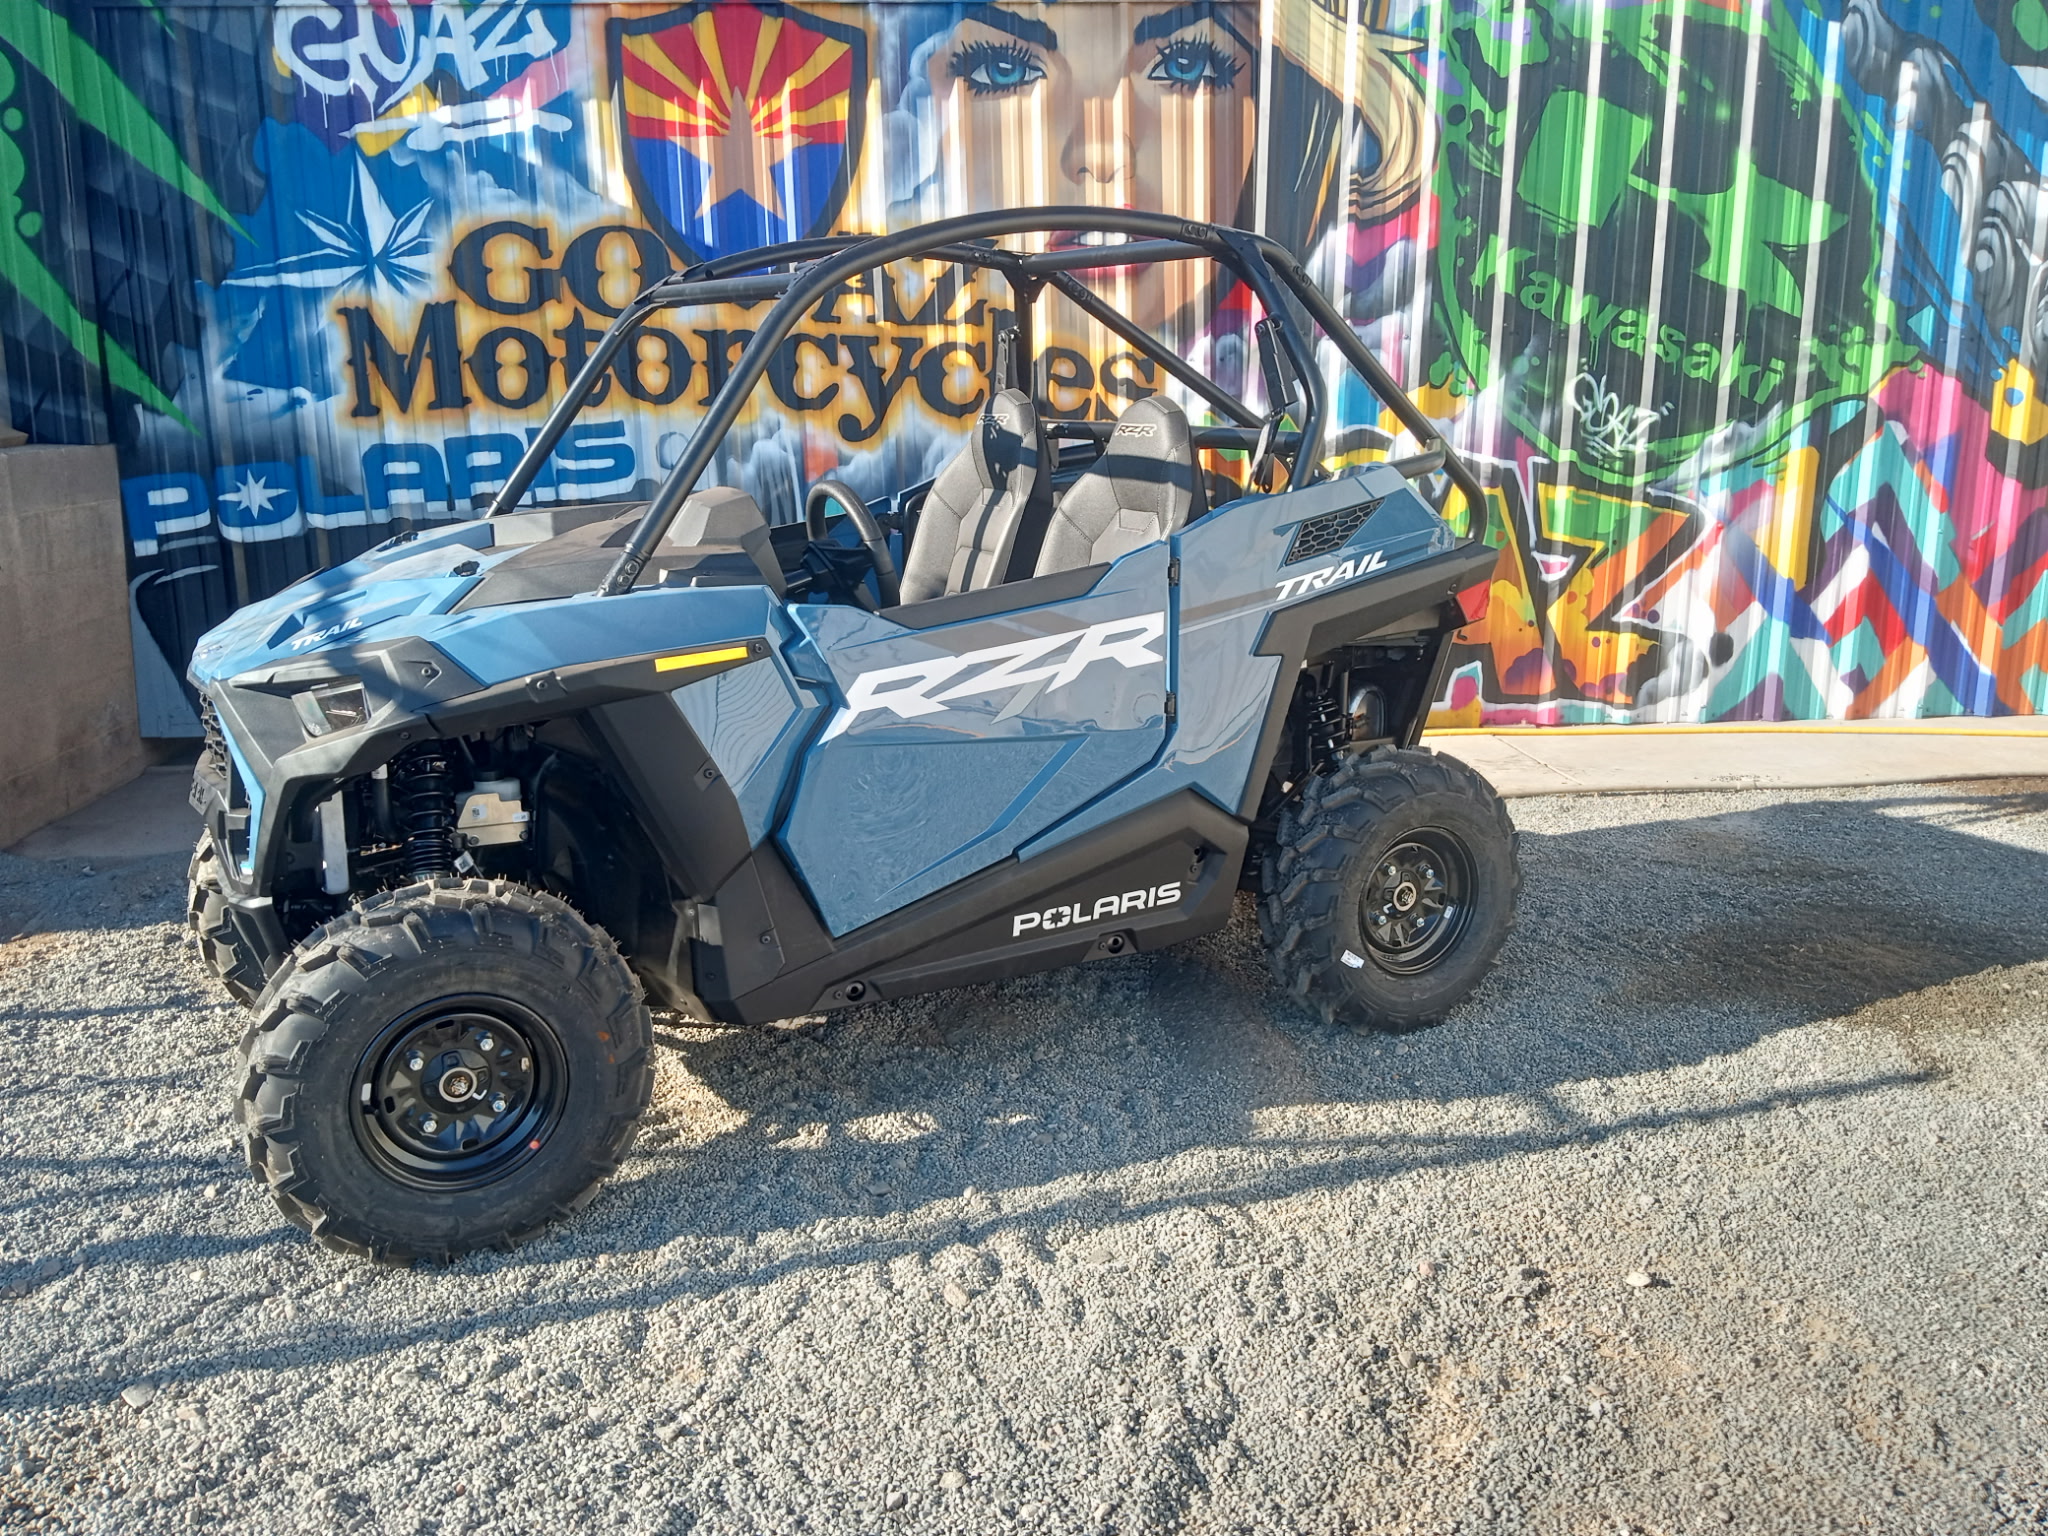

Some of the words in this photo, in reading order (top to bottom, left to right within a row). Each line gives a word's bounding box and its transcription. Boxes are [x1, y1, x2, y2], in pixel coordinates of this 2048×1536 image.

[448, 220, 675, 318] GO
[1470, 234, 1786, 405] Kawasaki
[977, 413, 1009, 426] RZR
[1115, 423, 1156, 438] RZR
[122, 420, 636, 557] POLARIS
[1275, 550, 1388, 601] TRAIL
[291, 618, 363, 651] TRAIL
[818, 612, 1164, 745] RZR
[1012, 881, 1181, 937] POLARIS
